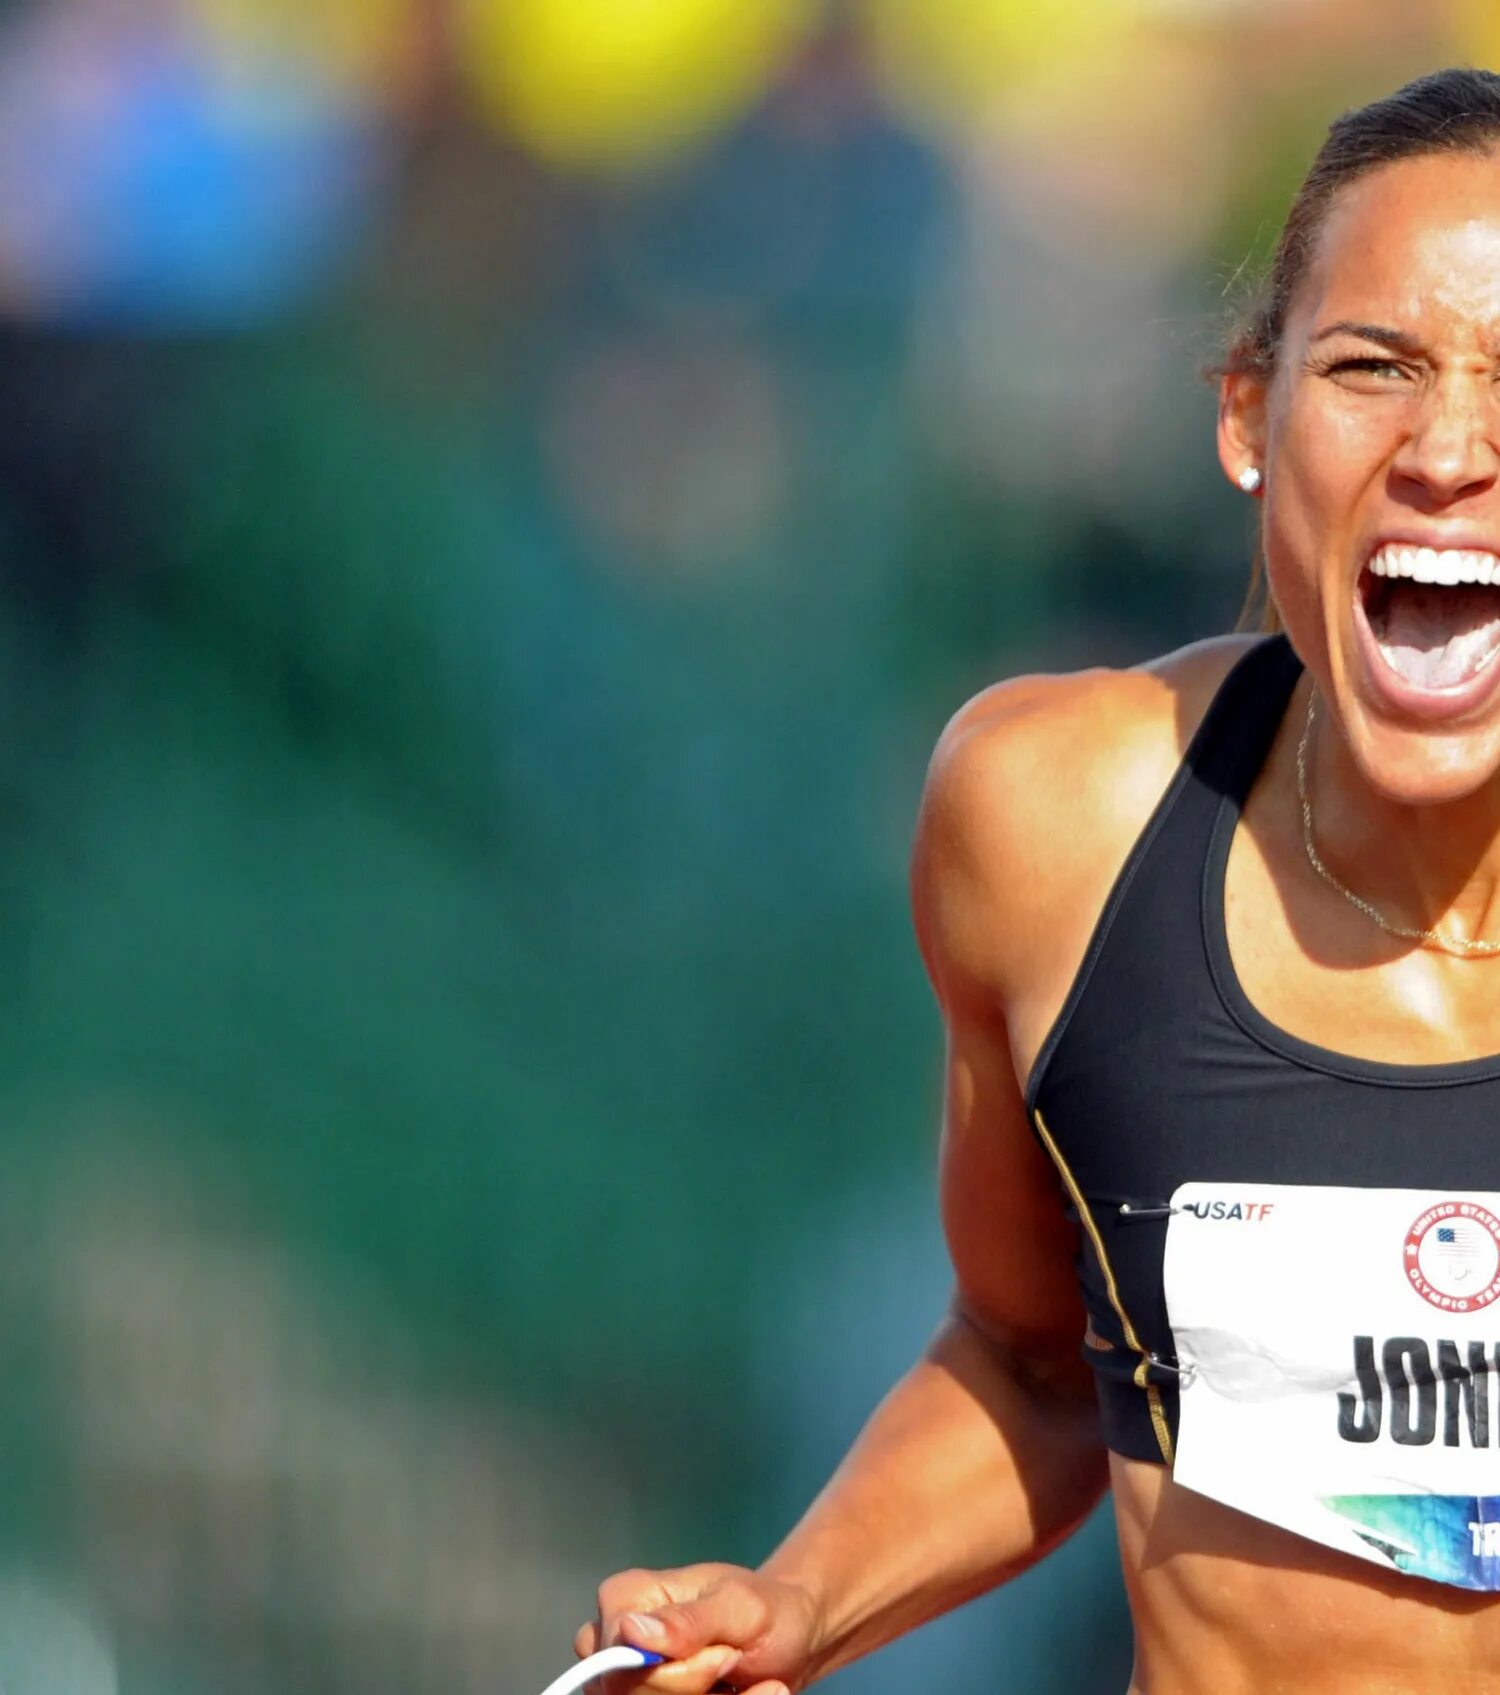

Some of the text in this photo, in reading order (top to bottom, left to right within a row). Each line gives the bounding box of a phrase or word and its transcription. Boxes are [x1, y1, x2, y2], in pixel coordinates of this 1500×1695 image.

[1193, 1200, 1275, 1221] USATF
[1411, 1203, 1457, 1237] UNITED
[1408, 1267, 1469, 1311] OLYMPIC
